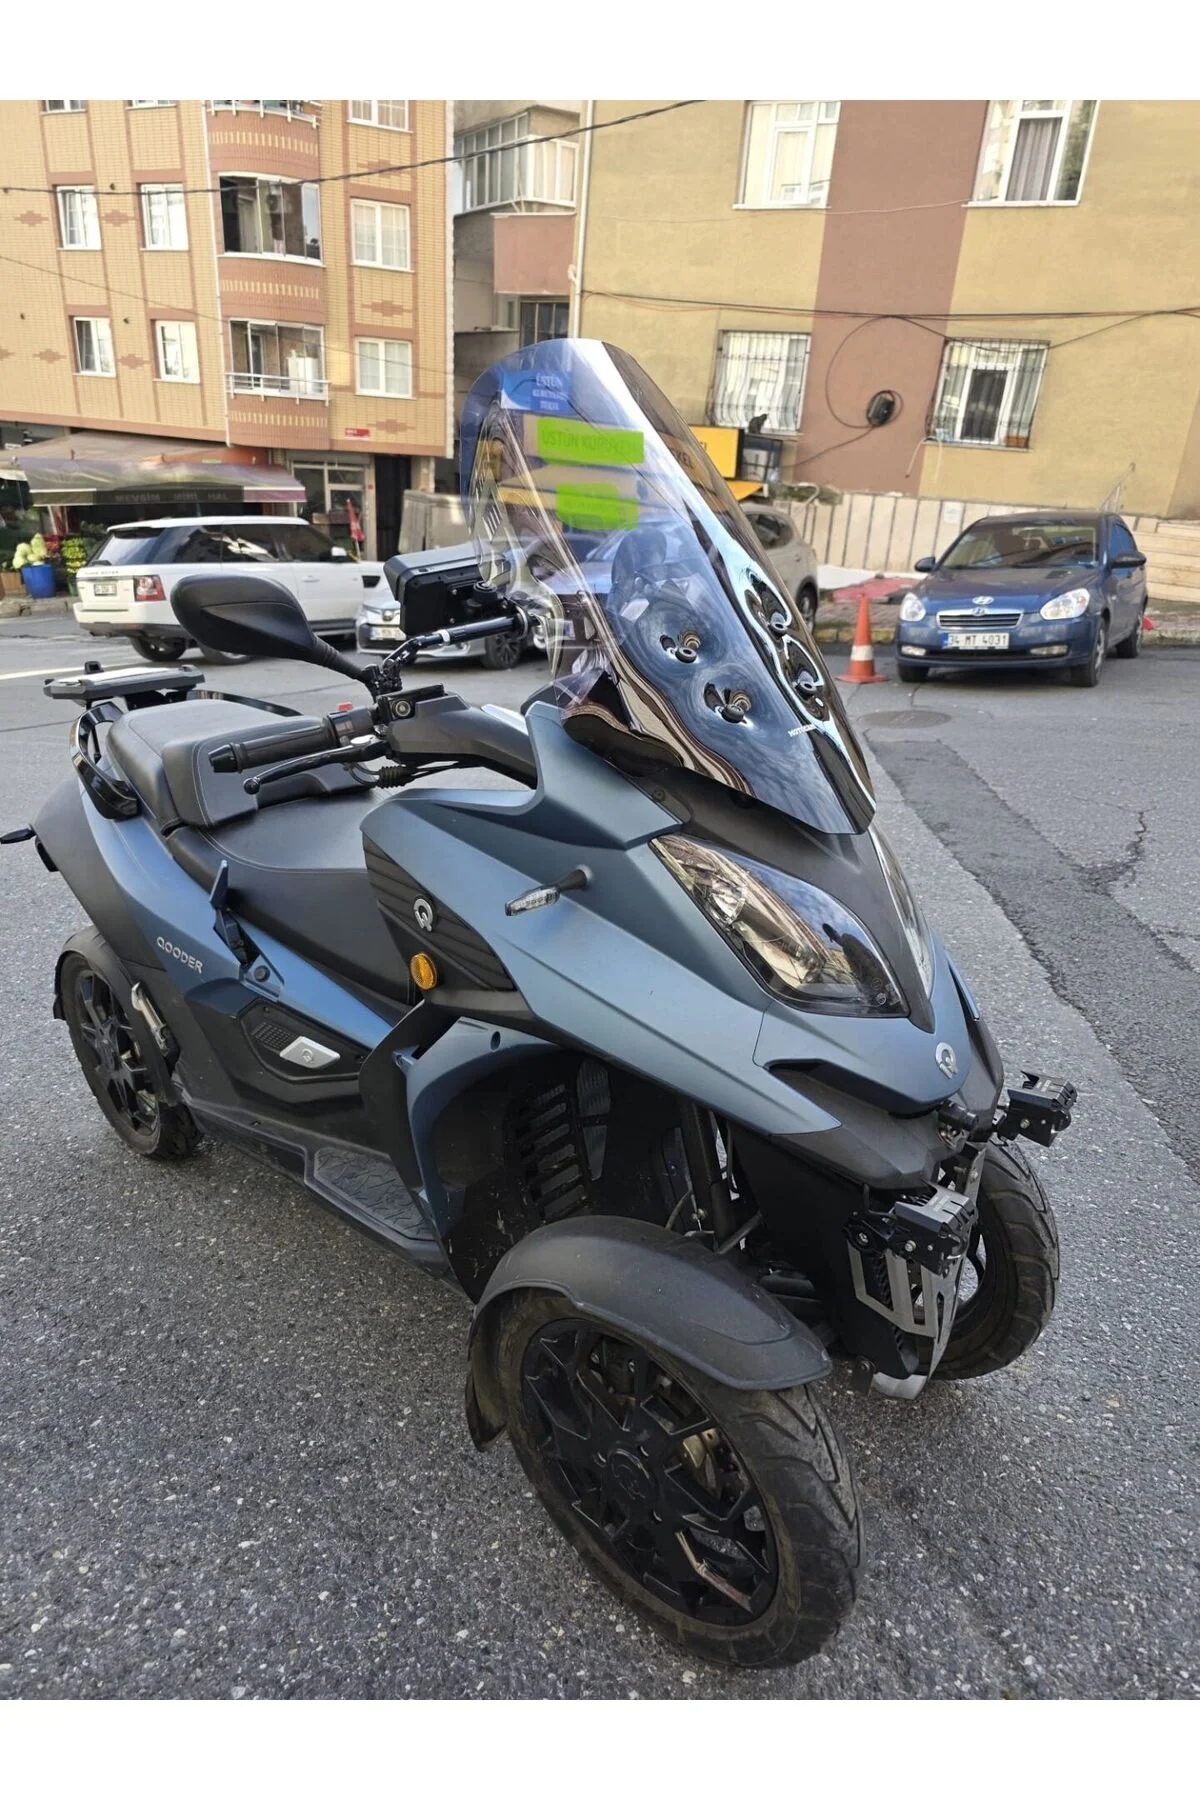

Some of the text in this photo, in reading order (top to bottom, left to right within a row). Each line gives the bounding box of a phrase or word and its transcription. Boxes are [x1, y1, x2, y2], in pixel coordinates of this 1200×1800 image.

[950, 635, 1007, 645] 34 MT 4031
[156, 936, 203, 974] QOODER
